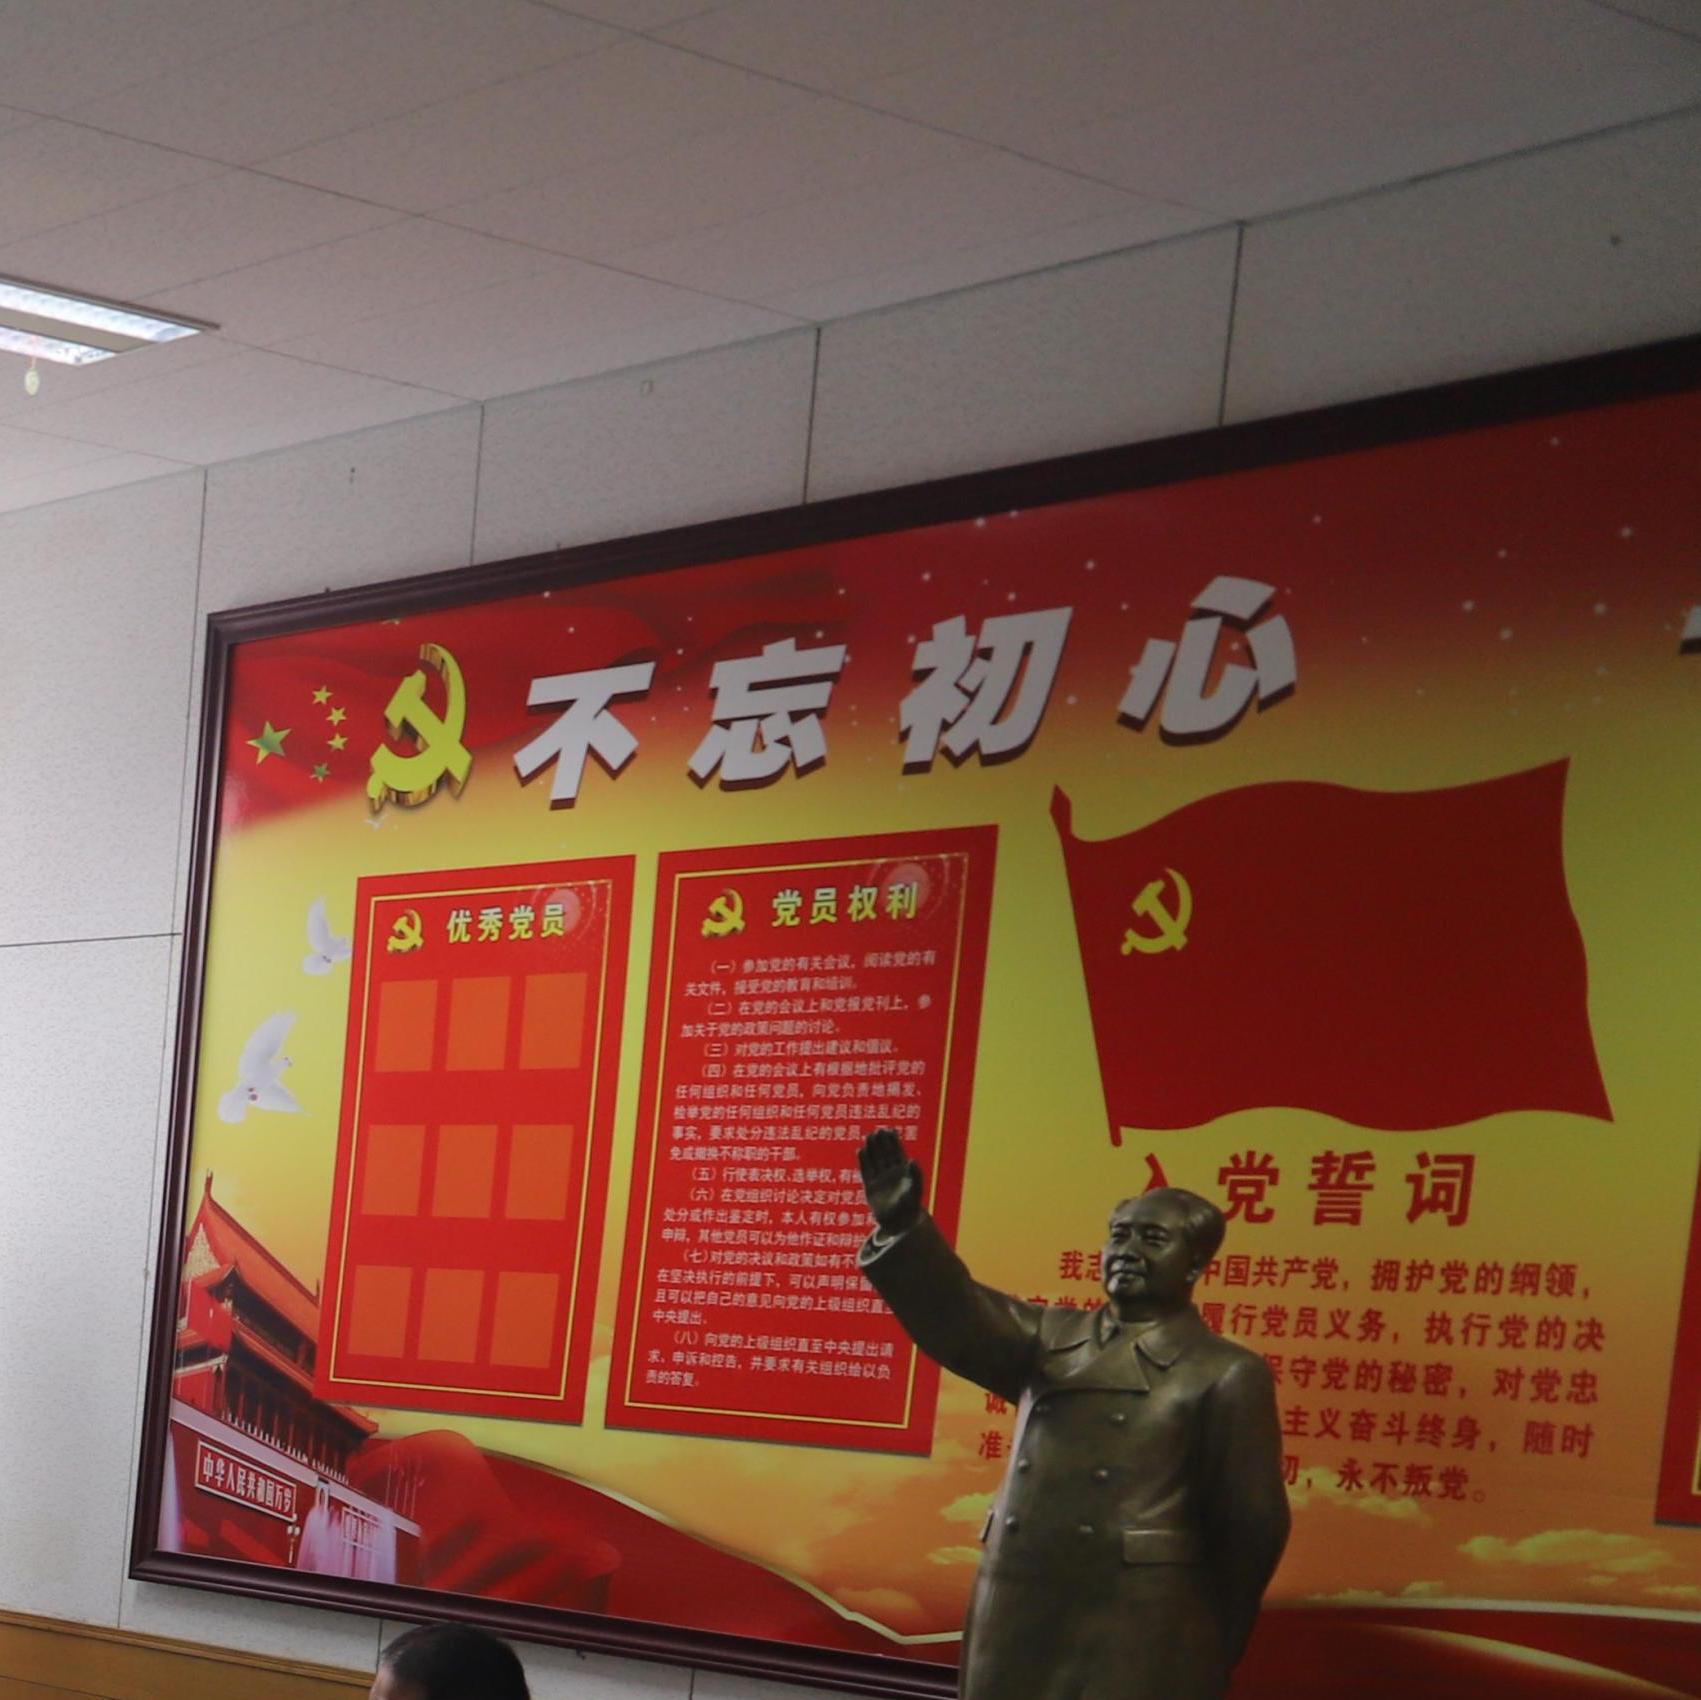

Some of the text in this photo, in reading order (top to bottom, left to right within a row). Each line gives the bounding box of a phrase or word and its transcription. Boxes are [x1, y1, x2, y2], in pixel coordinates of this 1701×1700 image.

[513, 575, 1298, 810] 不忘初心
[446, 901, 567, 946] 优秀党员
[770, 880, 920, 928] 党员权利
